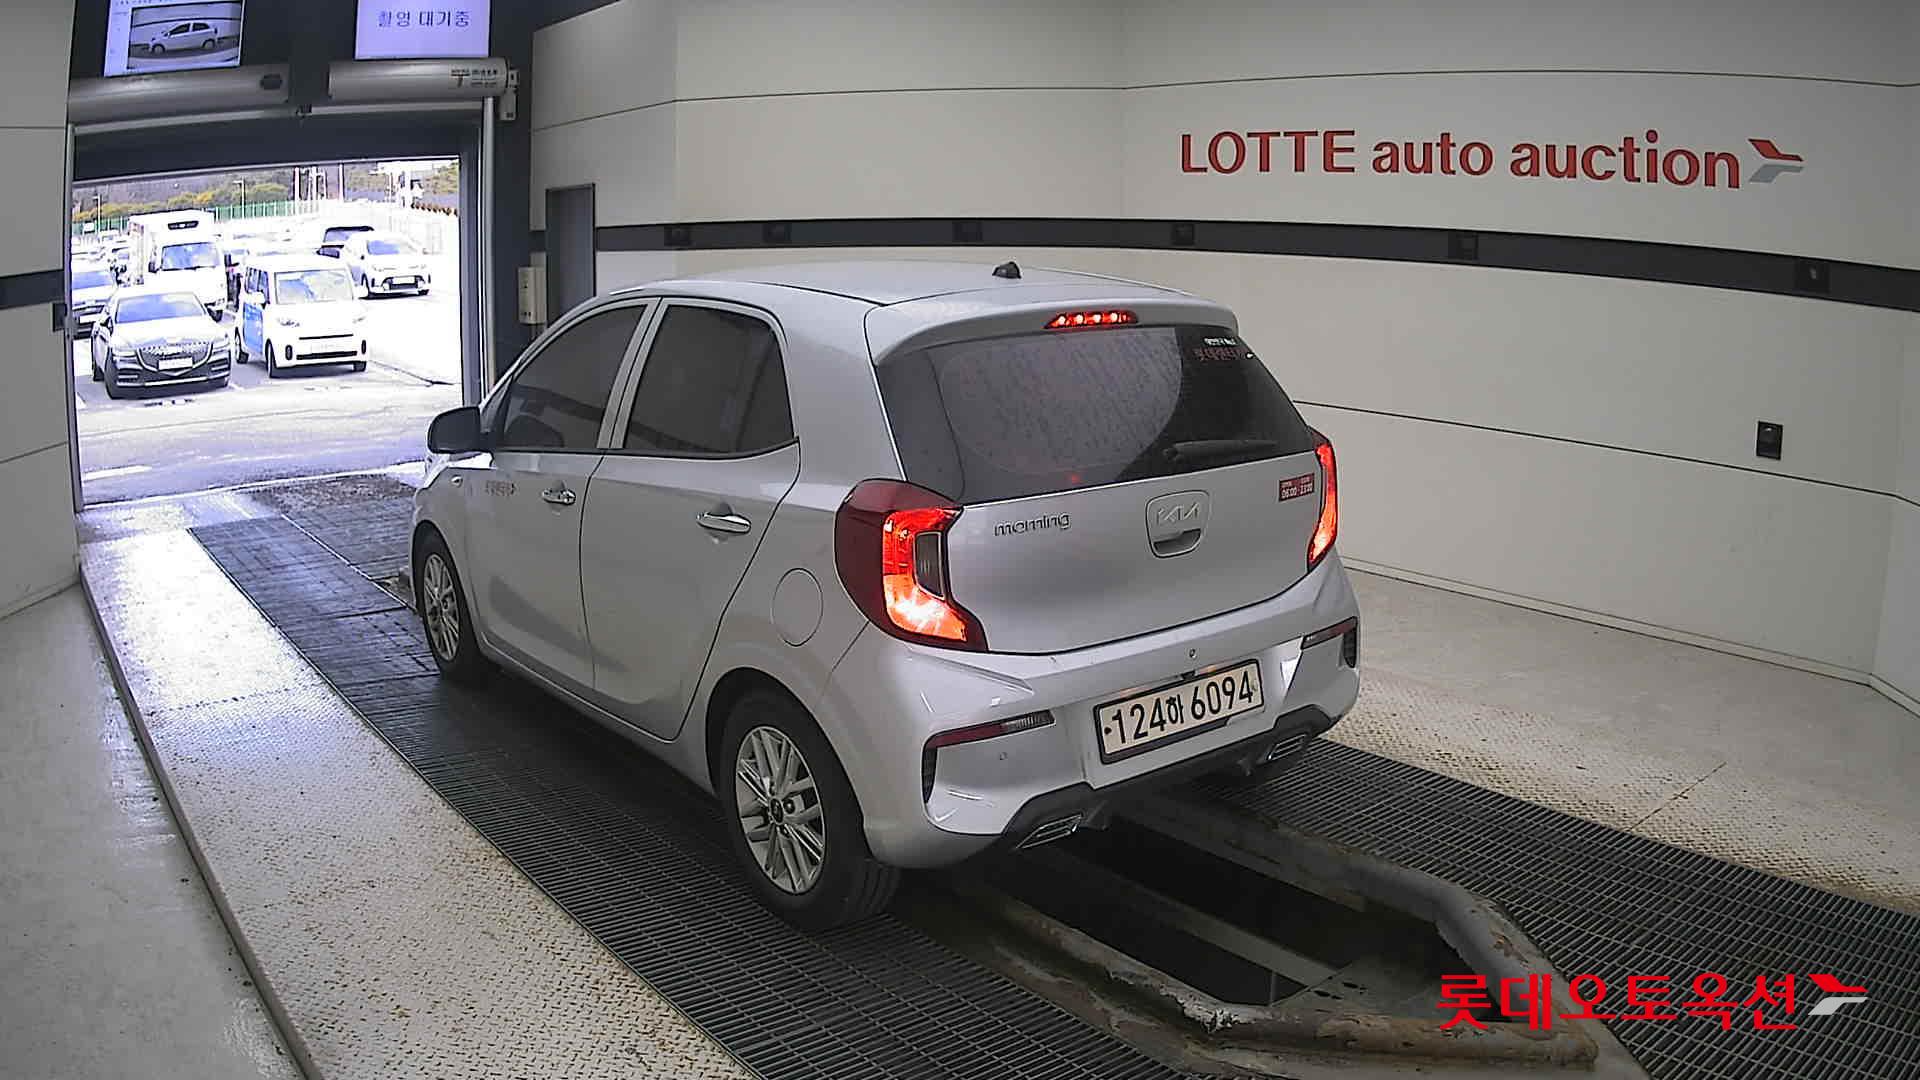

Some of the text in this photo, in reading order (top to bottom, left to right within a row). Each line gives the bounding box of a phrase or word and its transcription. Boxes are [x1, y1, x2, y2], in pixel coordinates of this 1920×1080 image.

[418, 9, 470, 28] 대기중
[1180, 129, 1741, 189] LOTTE auto auction
[994, 513, 1071, 537] morning
[1111, 671, 1253, 744] 124하 6094
